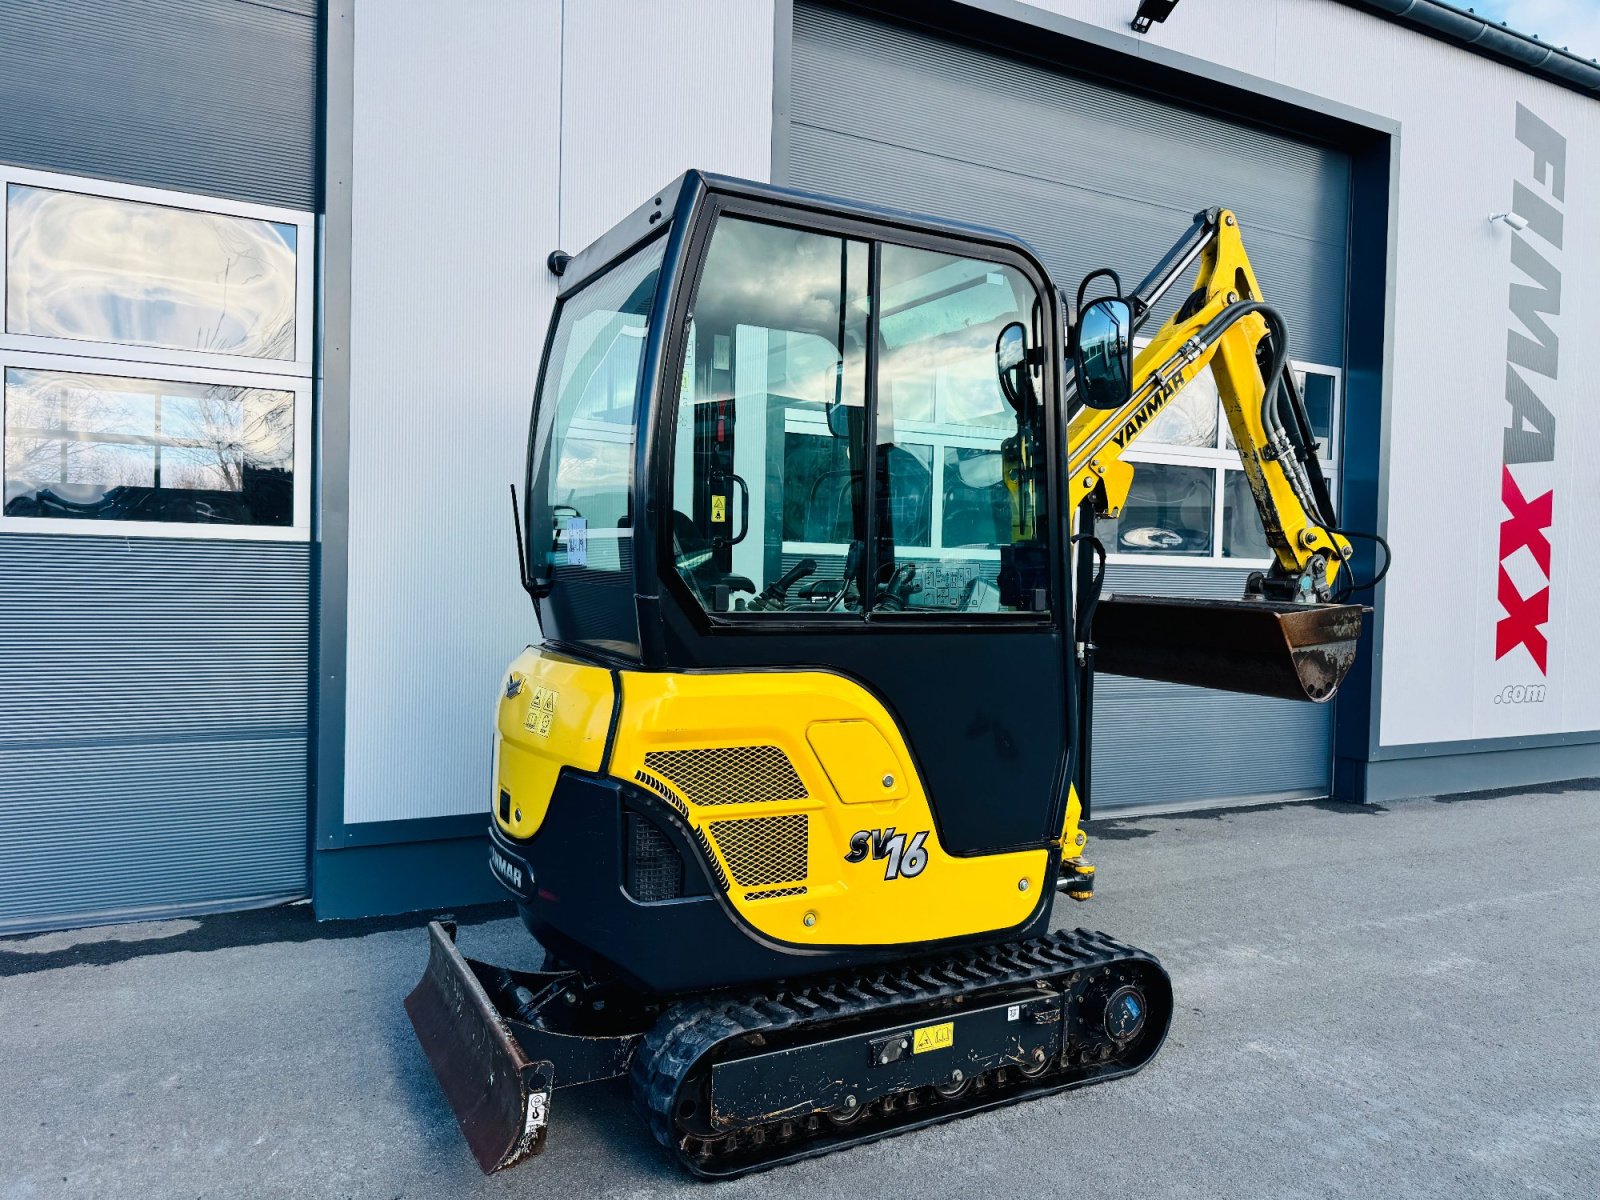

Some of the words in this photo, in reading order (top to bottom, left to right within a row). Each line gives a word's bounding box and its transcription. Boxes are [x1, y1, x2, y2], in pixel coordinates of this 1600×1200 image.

[1112, 371, 1186, 449] YANMAR
[1495, 100, 1567, 677] FIMAXX
[1494, 684, 1546, 705] .com
